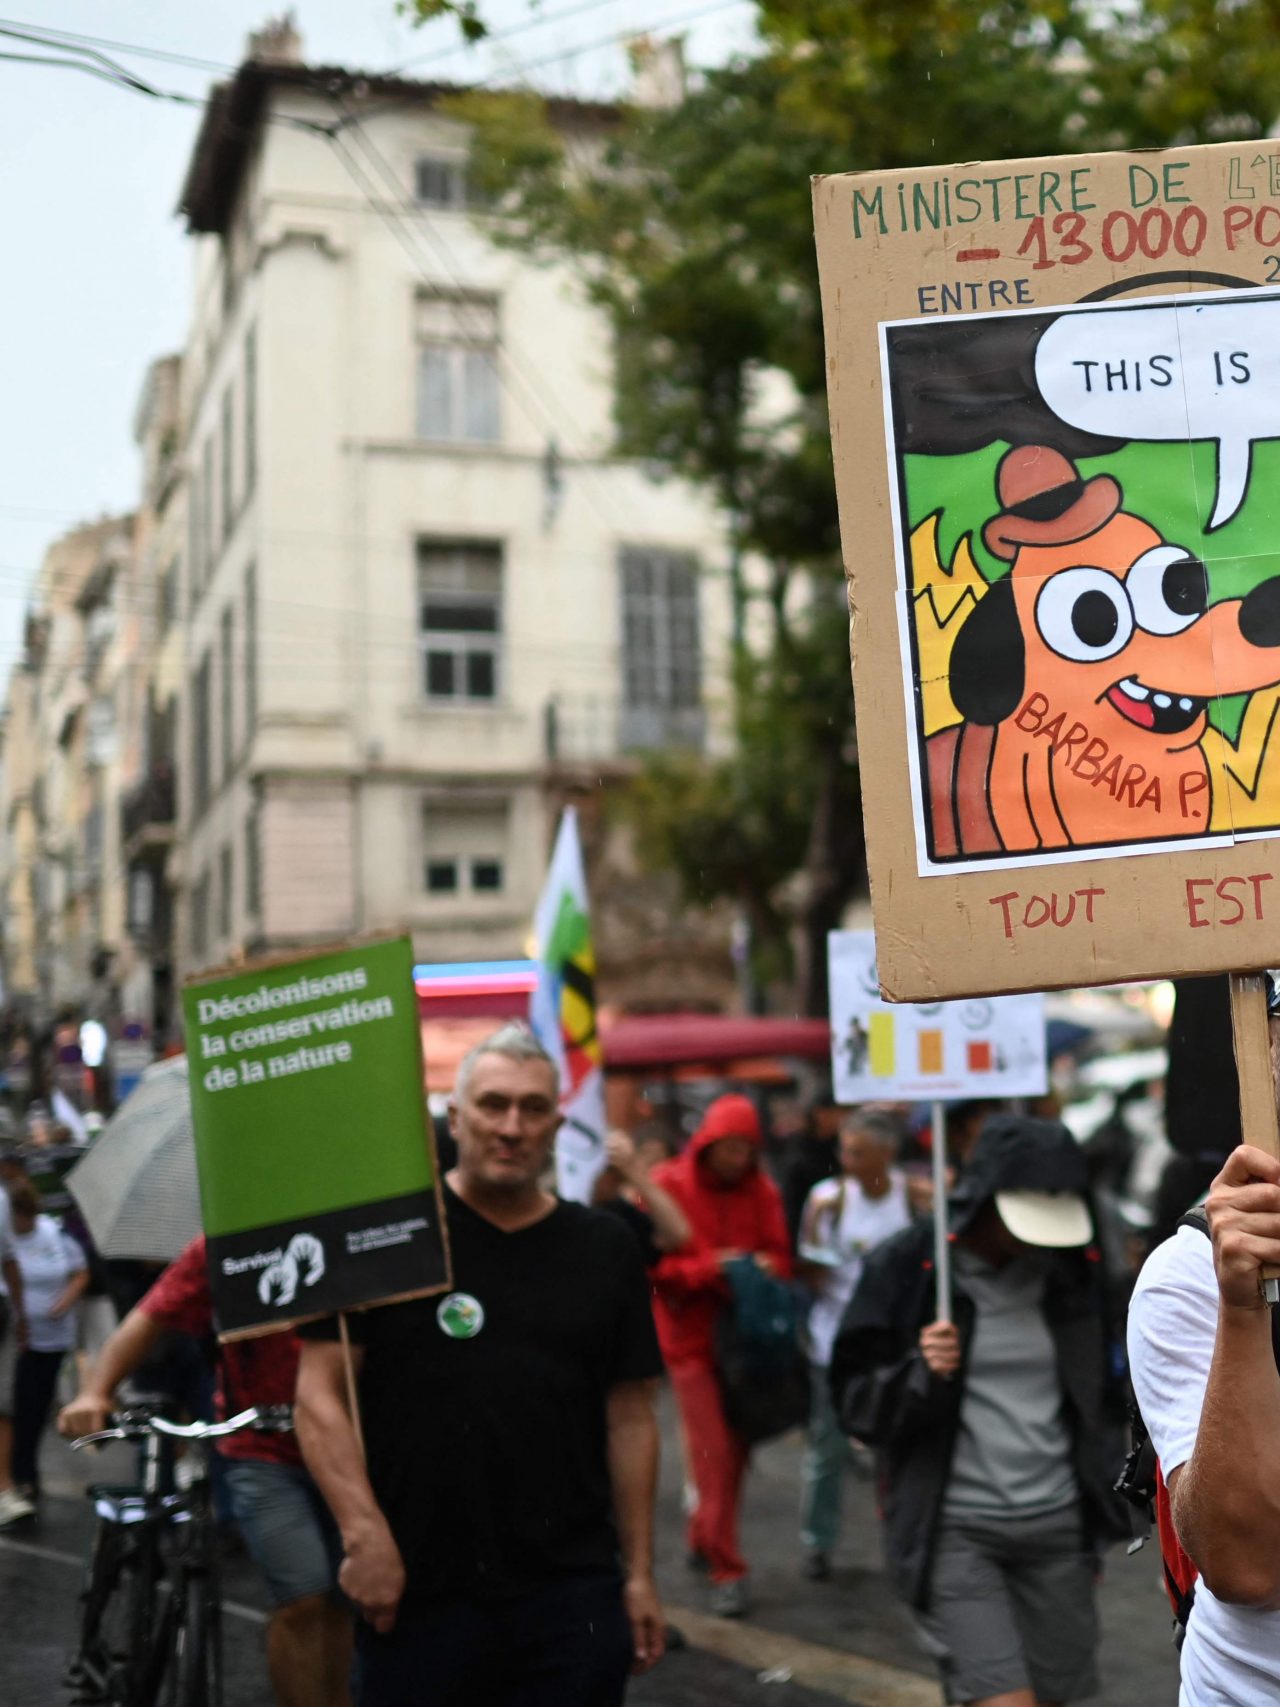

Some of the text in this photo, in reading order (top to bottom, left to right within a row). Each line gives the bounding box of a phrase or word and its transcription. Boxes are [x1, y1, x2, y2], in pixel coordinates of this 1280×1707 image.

[1129, 162, 1192, 208] DE
[918, 279, 1034, 313] ENTRE
[1073, 355, 1173, 392] THIS
[1214, 351, 1250, 386] IS
[1015, 692, 1208, 818] BARBARA P.
[989, 888, 1105, 938] TOUT
[1185, 873, 1274, 928] EST
[198, 967, 367, 1025] Décolonisons
[201, 996, 394, 1058] la conservation
[203, 1040, 352, 1092] de la nature
